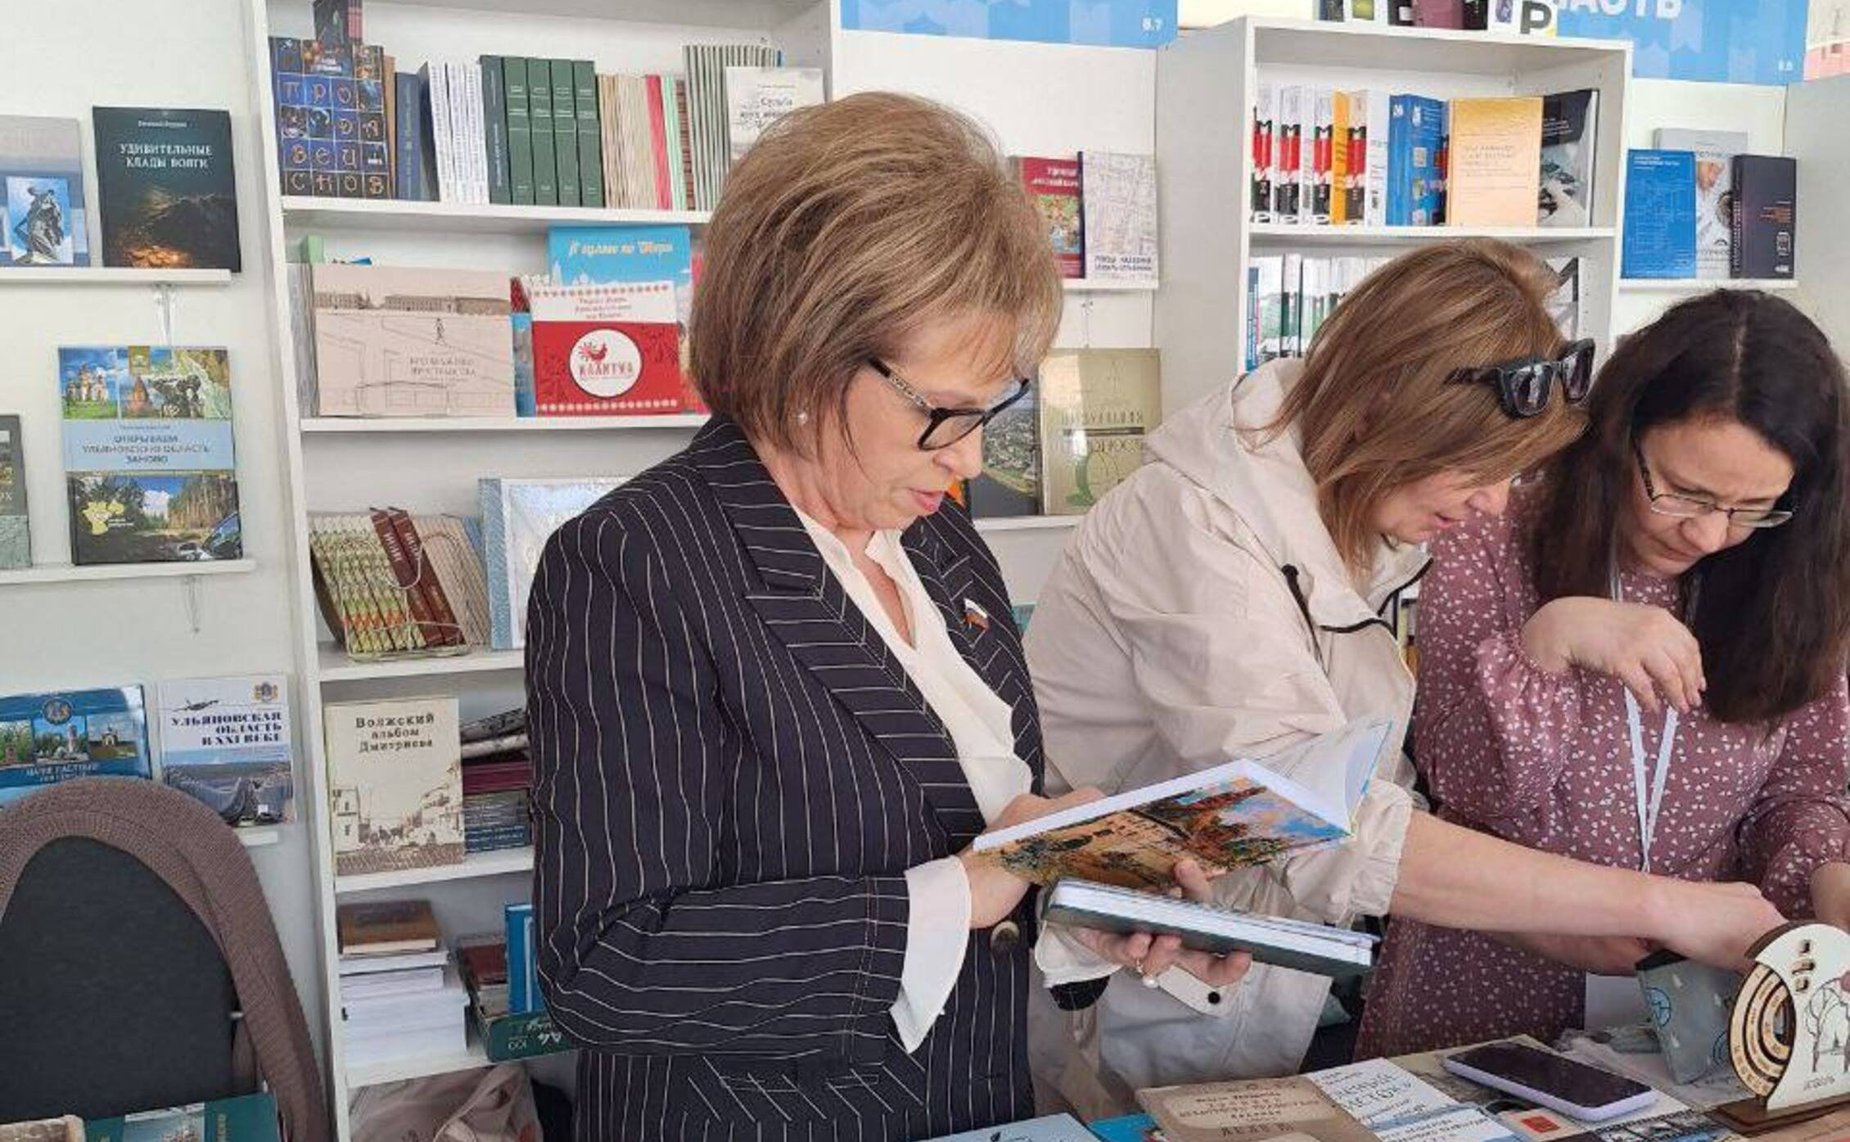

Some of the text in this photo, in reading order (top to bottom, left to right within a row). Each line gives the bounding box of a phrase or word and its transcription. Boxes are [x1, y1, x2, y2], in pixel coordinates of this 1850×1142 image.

[120, 143, 212, 156] УДИВИТЕЛЬНЫЕ
[126, 156, 166, 168] КЛАДЫ
[170, 711, 282, 726] УЛЬЯНОВСКАЯ
[355, 712, 435, 729] Волжский
[215, 722, 282, 734] ОБЛАСТЬ
[371, 727, 419, 740] альбом
[244, 732, 279, 743] ВЕКЕ
[358, 739, 434, 754] Дмитриева
